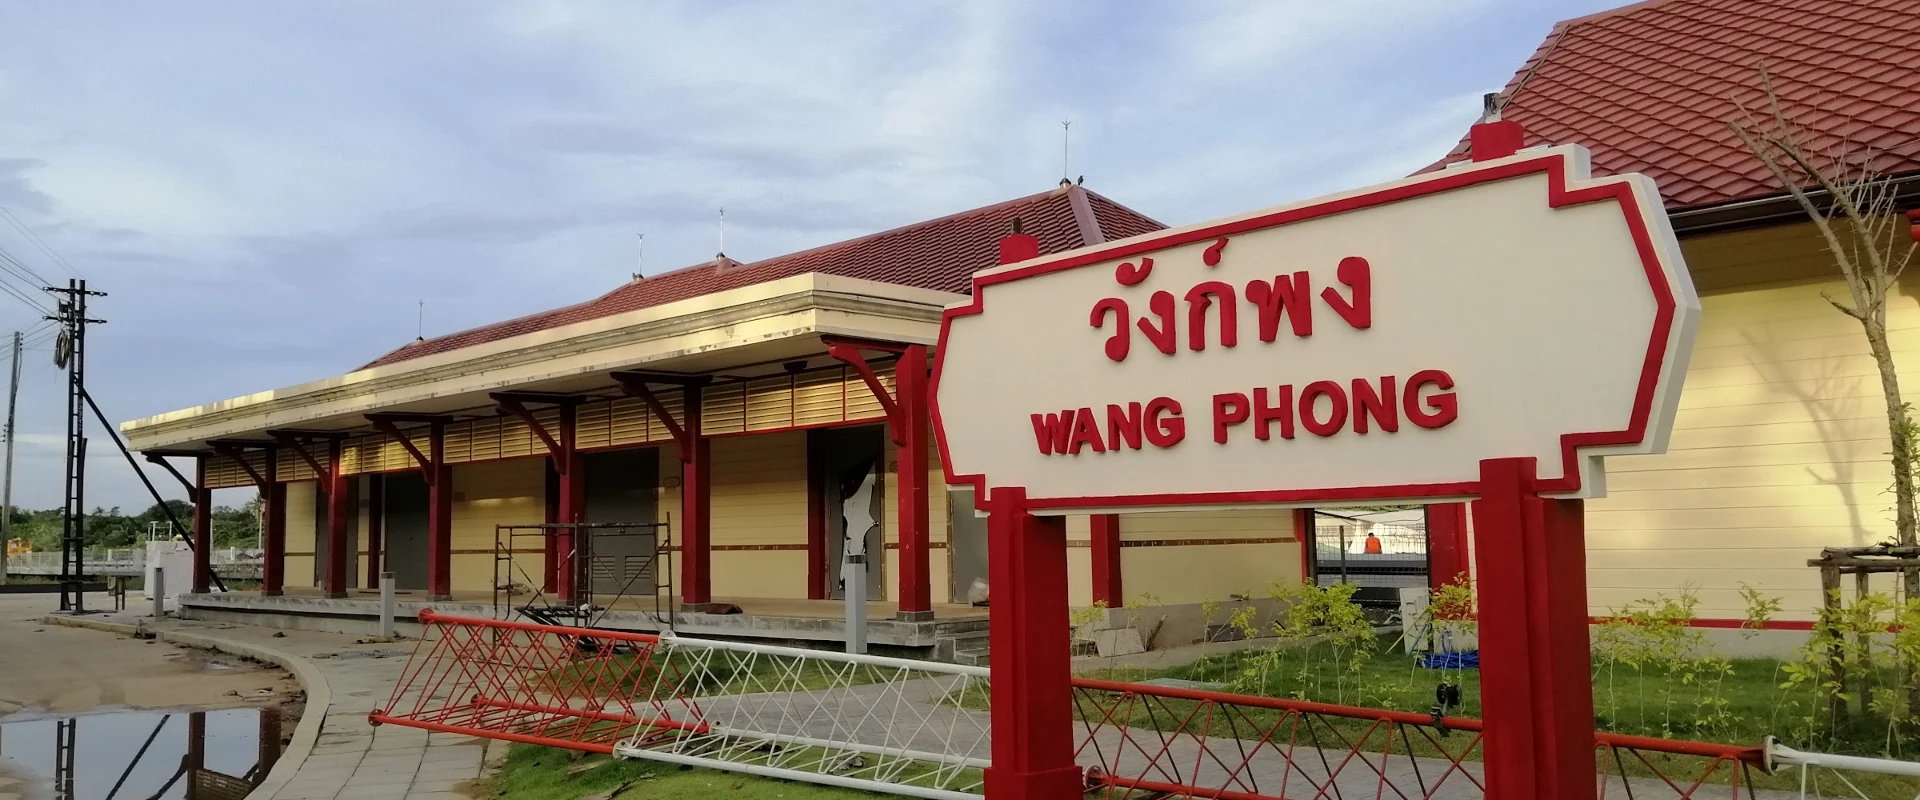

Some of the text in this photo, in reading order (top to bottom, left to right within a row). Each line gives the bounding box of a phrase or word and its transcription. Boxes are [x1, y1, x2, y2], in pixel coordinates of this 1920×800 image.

[1089, 237, 1373, 362] วังก์พง
[1030, 369, 1459, 455] WANG PHONG
